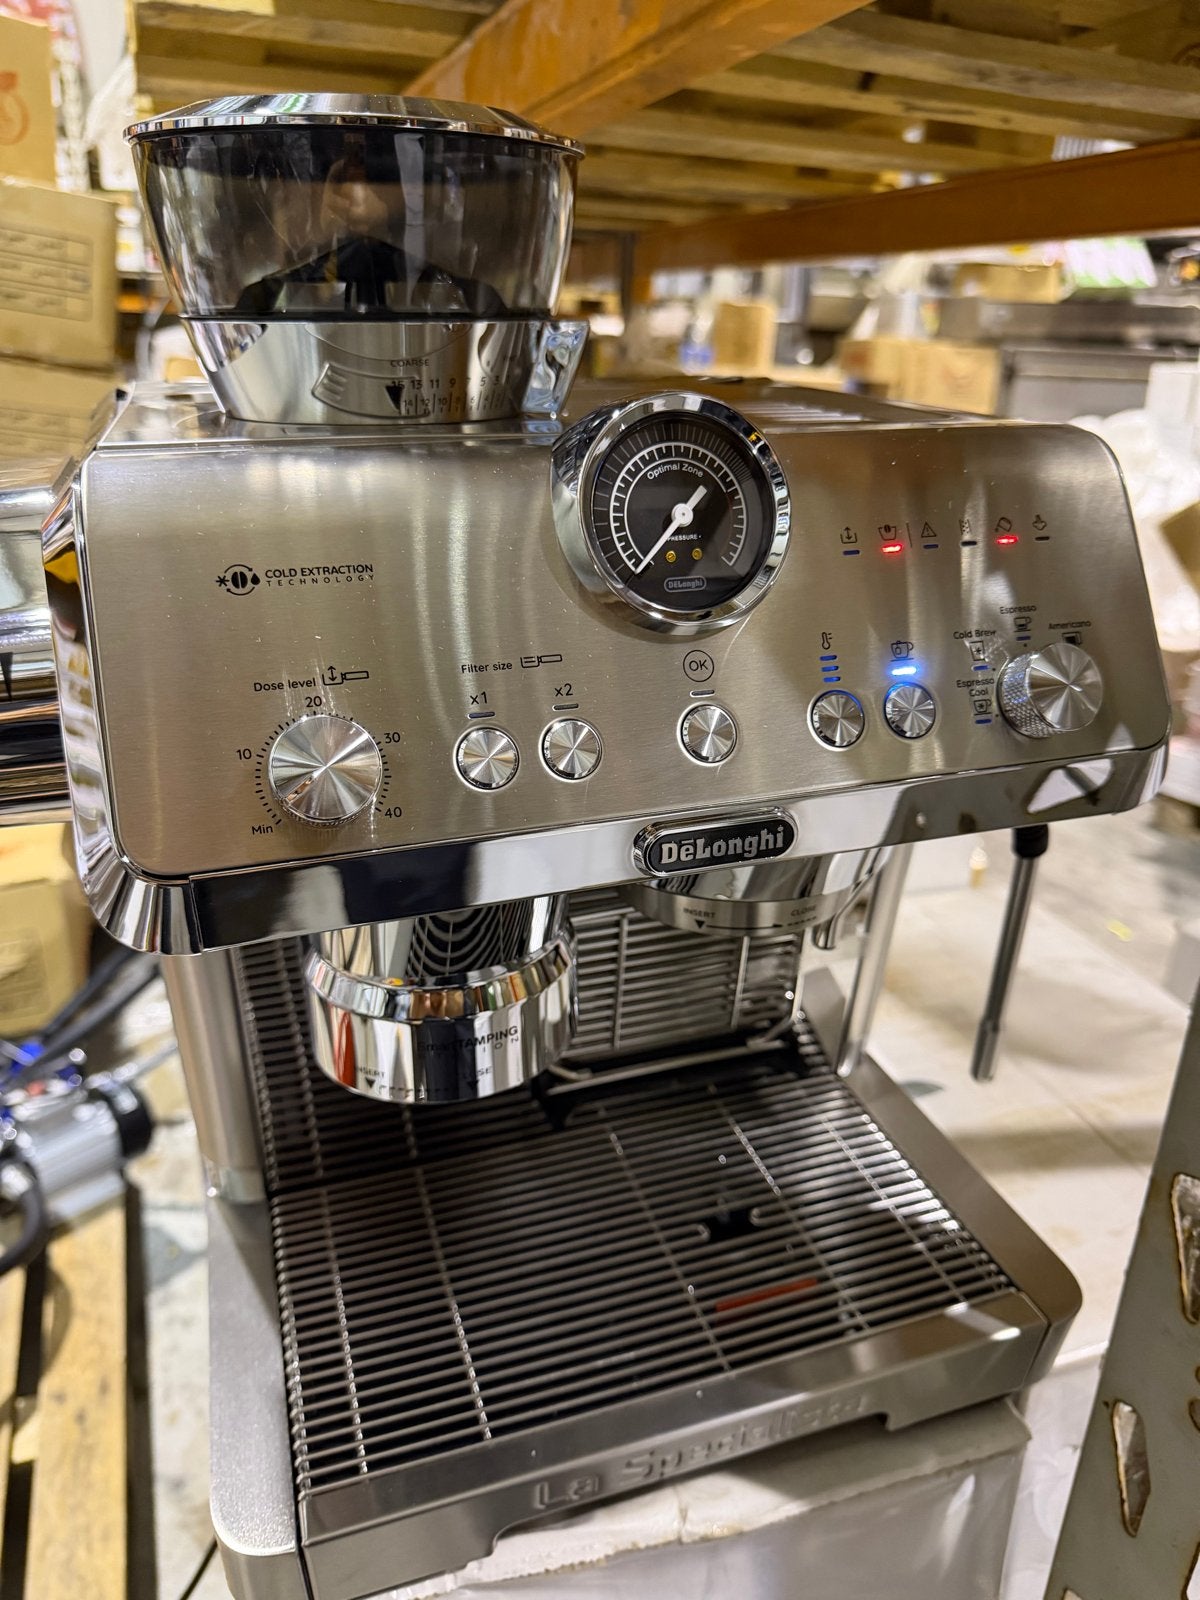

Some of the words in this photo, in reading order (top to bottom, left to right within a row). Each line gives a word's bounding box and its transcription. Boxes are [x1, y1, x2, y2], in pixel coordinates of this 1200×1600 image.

[390, 359, 430, 368] COARSE
[430, 378, 440, 389] 11
[449, 377, 456, 388] 9
[647, 463, 681, 480] Optimal
[682, 463, 704, 478] Zone
[265, 568, 298, 579] COLD
[301, 564, 374, 577] EXTRACTION
[266, 574, 375, 587] TECHNOLOGY
[1000, 604, 1037, 615] Espresso
[1048, 619, 1092, 630] Americano
[953, 630, 973, 640] Cold
[975, 629, 997, 637] Brew
[461, 662, 490, 674] Filter
[492, 661, 513, 671] size
[689, 659, 709, 671] OK
[254, 682, 285, 692] Dose
[288, 677, 317, 689] level
[956, 678, 995, 689] Espresso
[554, 683, 574, 697] x2
[969, 688, 989, 697] Cool
[305, 695, 323, 708] 20
[470, 691, 488, 705] x1
[384, 731, 401, 744] 30
[236, 748, 252, 760] 10
[384, 806, 403, 819] 40
[252, 824, 273, 836] Min
[683, 907, 716, 918] INSERT
[533, 1474, 599, 1510] La
